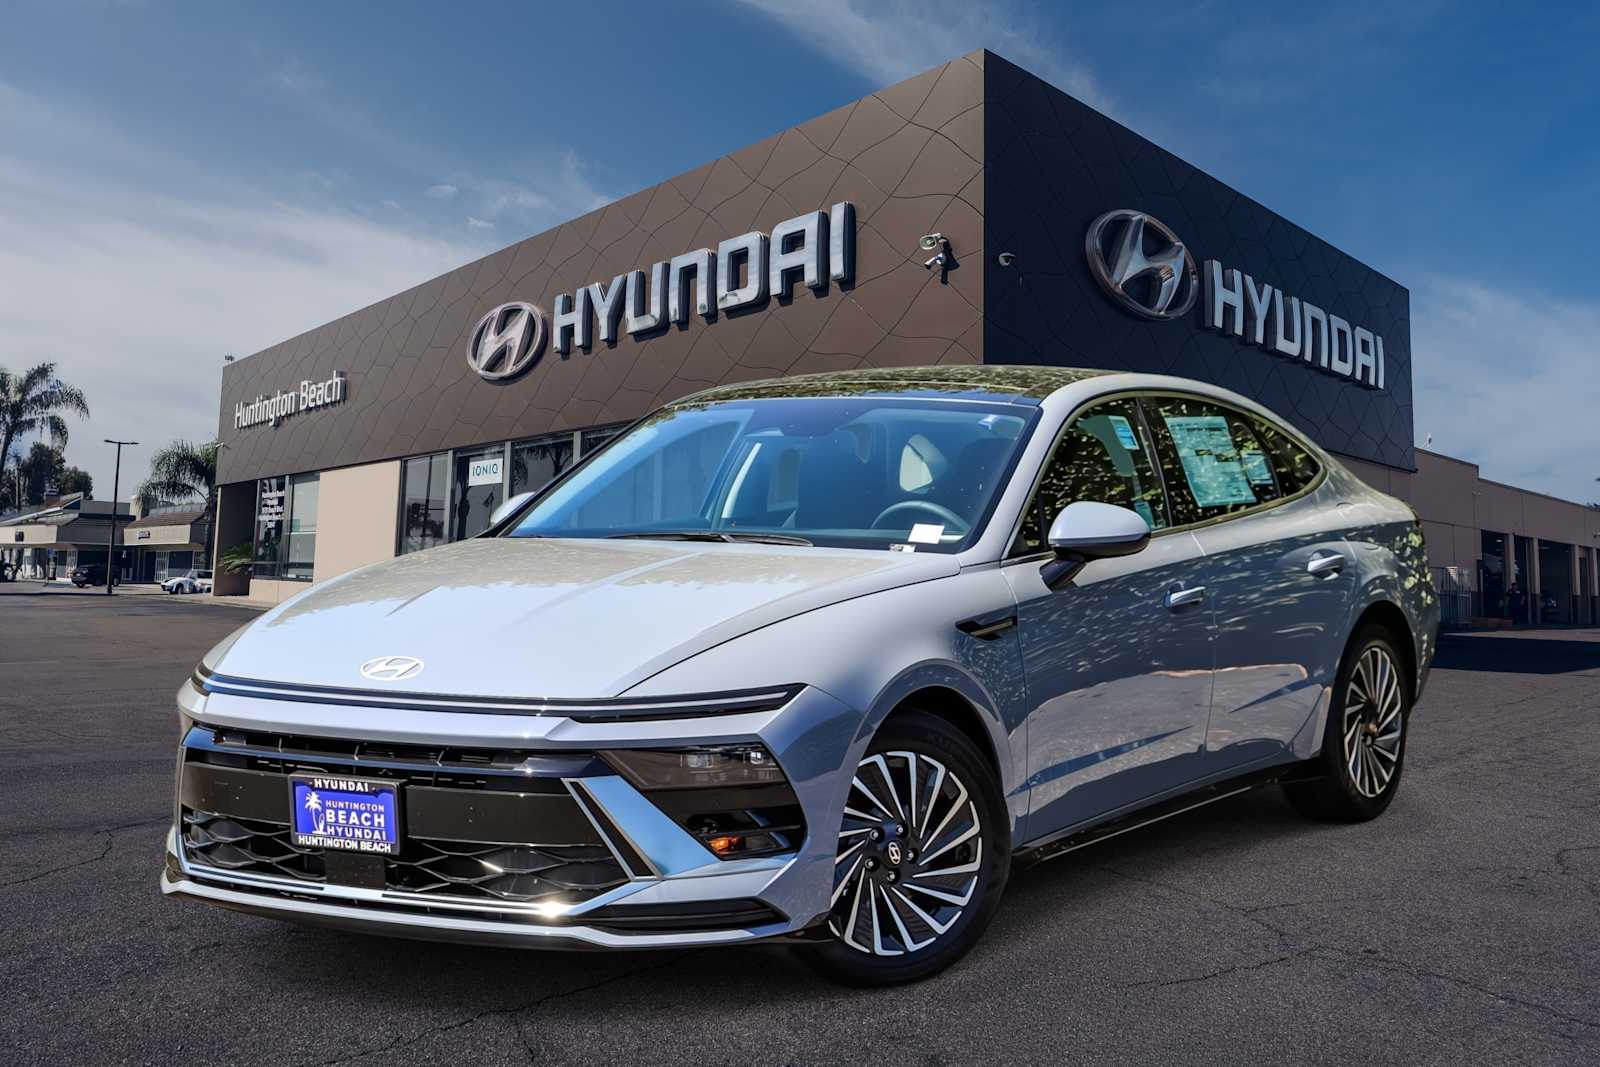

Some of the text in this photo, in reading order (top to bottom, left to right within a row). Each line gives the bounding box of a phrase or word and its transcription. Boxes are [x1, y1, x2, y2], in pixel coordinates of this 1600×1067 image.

[552, 201, 854, 355] HYUNDAI
[1203, 259, 1385, 389] HYUNDAI
[234, 370, 343, 429] Huntington Beach
[314, 778, 369, 792] HYUNDAI
[325, 800, 385, 812] HUNTINGTON
[325, 809, 385, 828] BEACH
[326, 825, 386, 841] HYUNDAI
[298, 835, 391, 853] HUNTINGTON BEACH
